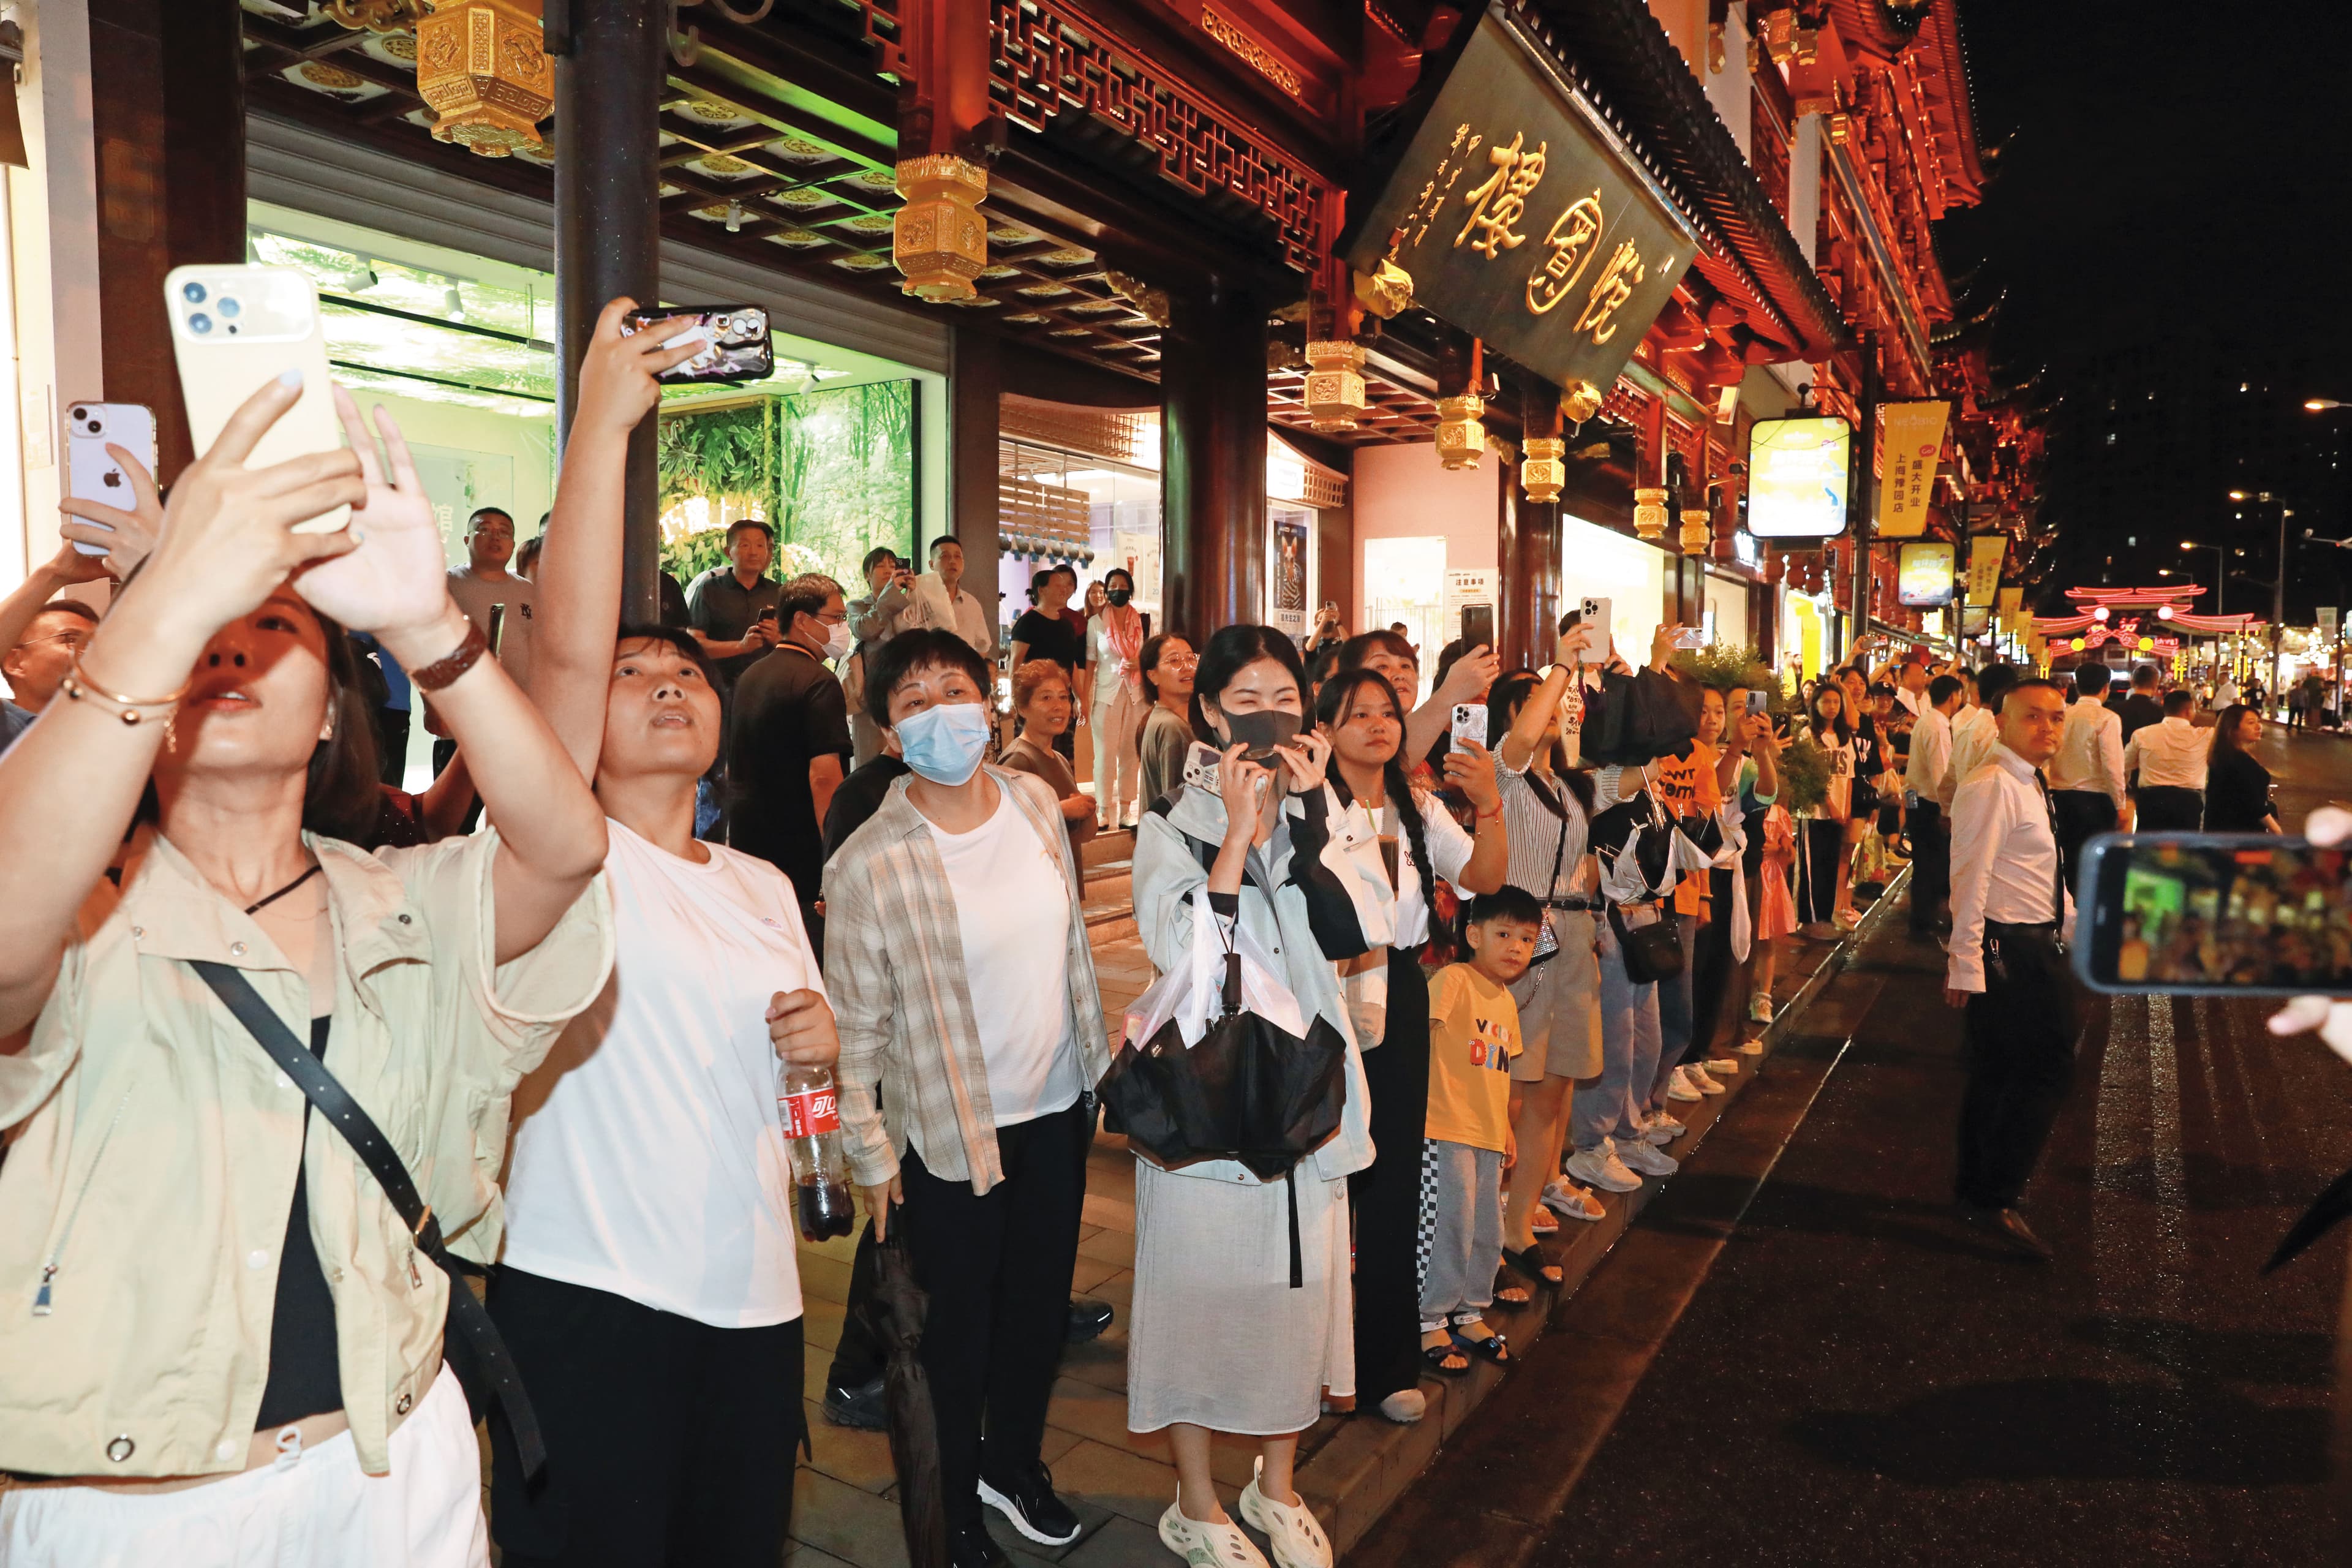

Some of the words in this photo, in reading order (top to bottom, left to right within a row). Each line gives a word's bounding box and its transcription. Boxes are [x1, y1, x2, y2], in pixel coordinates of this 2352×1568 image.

[1893, 453, 1907, 513] 上海豫园店
[1910, 459, 1923, 507] 盛大开业
